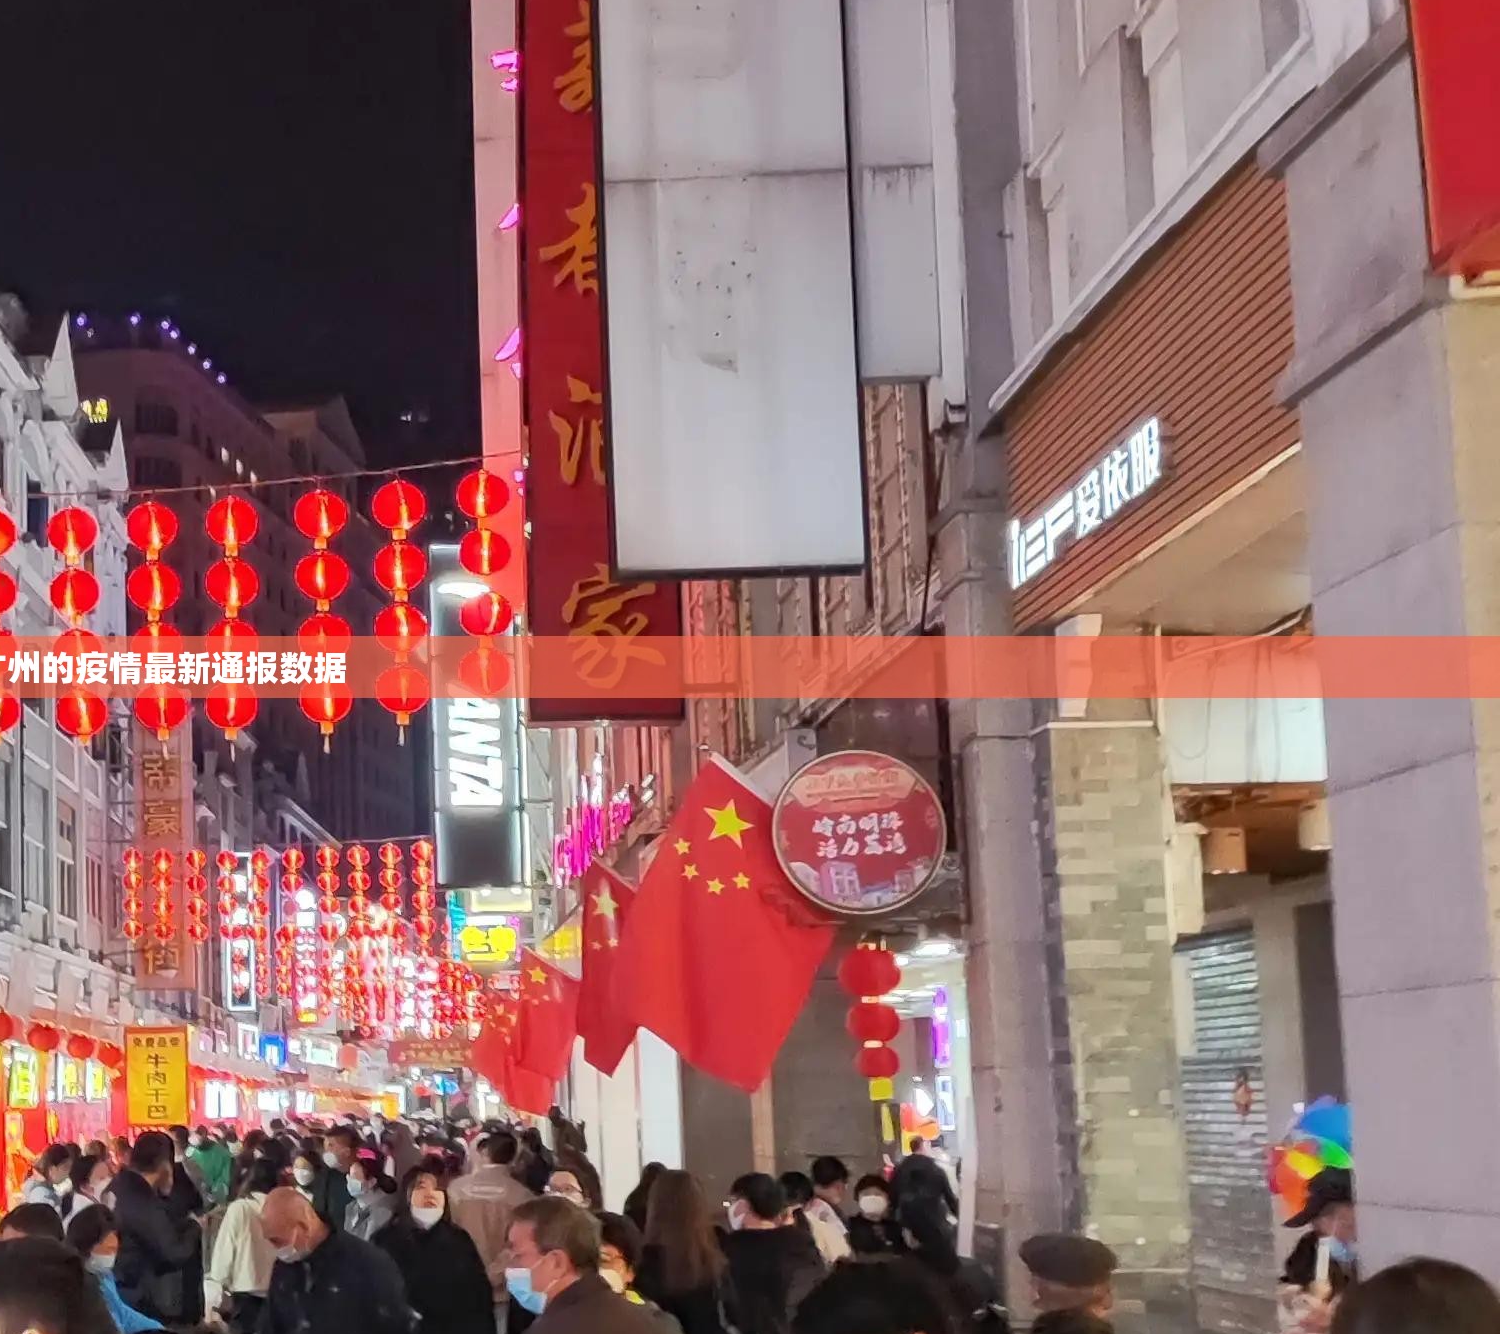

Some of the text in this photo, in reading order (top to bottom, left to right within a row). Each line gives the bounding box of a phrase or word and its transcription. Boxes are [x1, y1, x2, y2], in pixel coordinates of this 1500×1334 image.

[447, 680, 503, 807] ANTA
[144, 1052, 171, 1120] 牛肉干巴
